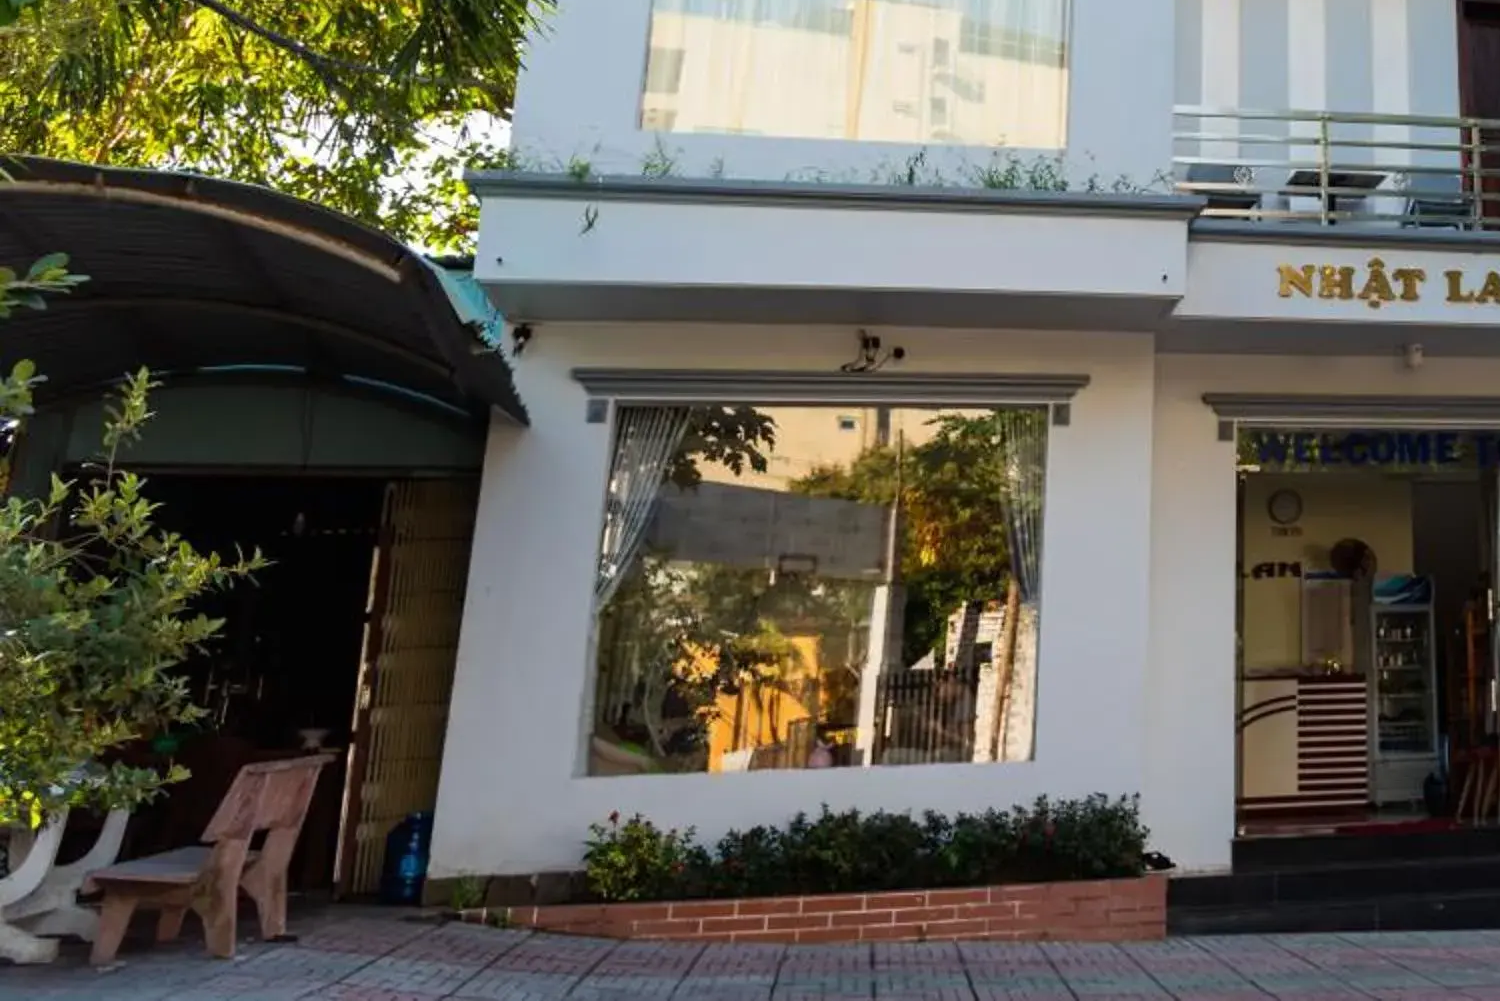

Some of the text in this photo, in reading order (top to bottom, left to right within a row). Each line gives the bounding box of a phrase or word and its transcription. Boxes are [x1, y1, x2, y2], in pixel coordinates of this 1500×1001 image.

[1276, 257, 1426, 308] NHẬT
[1255, 431, 1459, 465] WELCOME
[1243, 561, 1302, 580] AN
